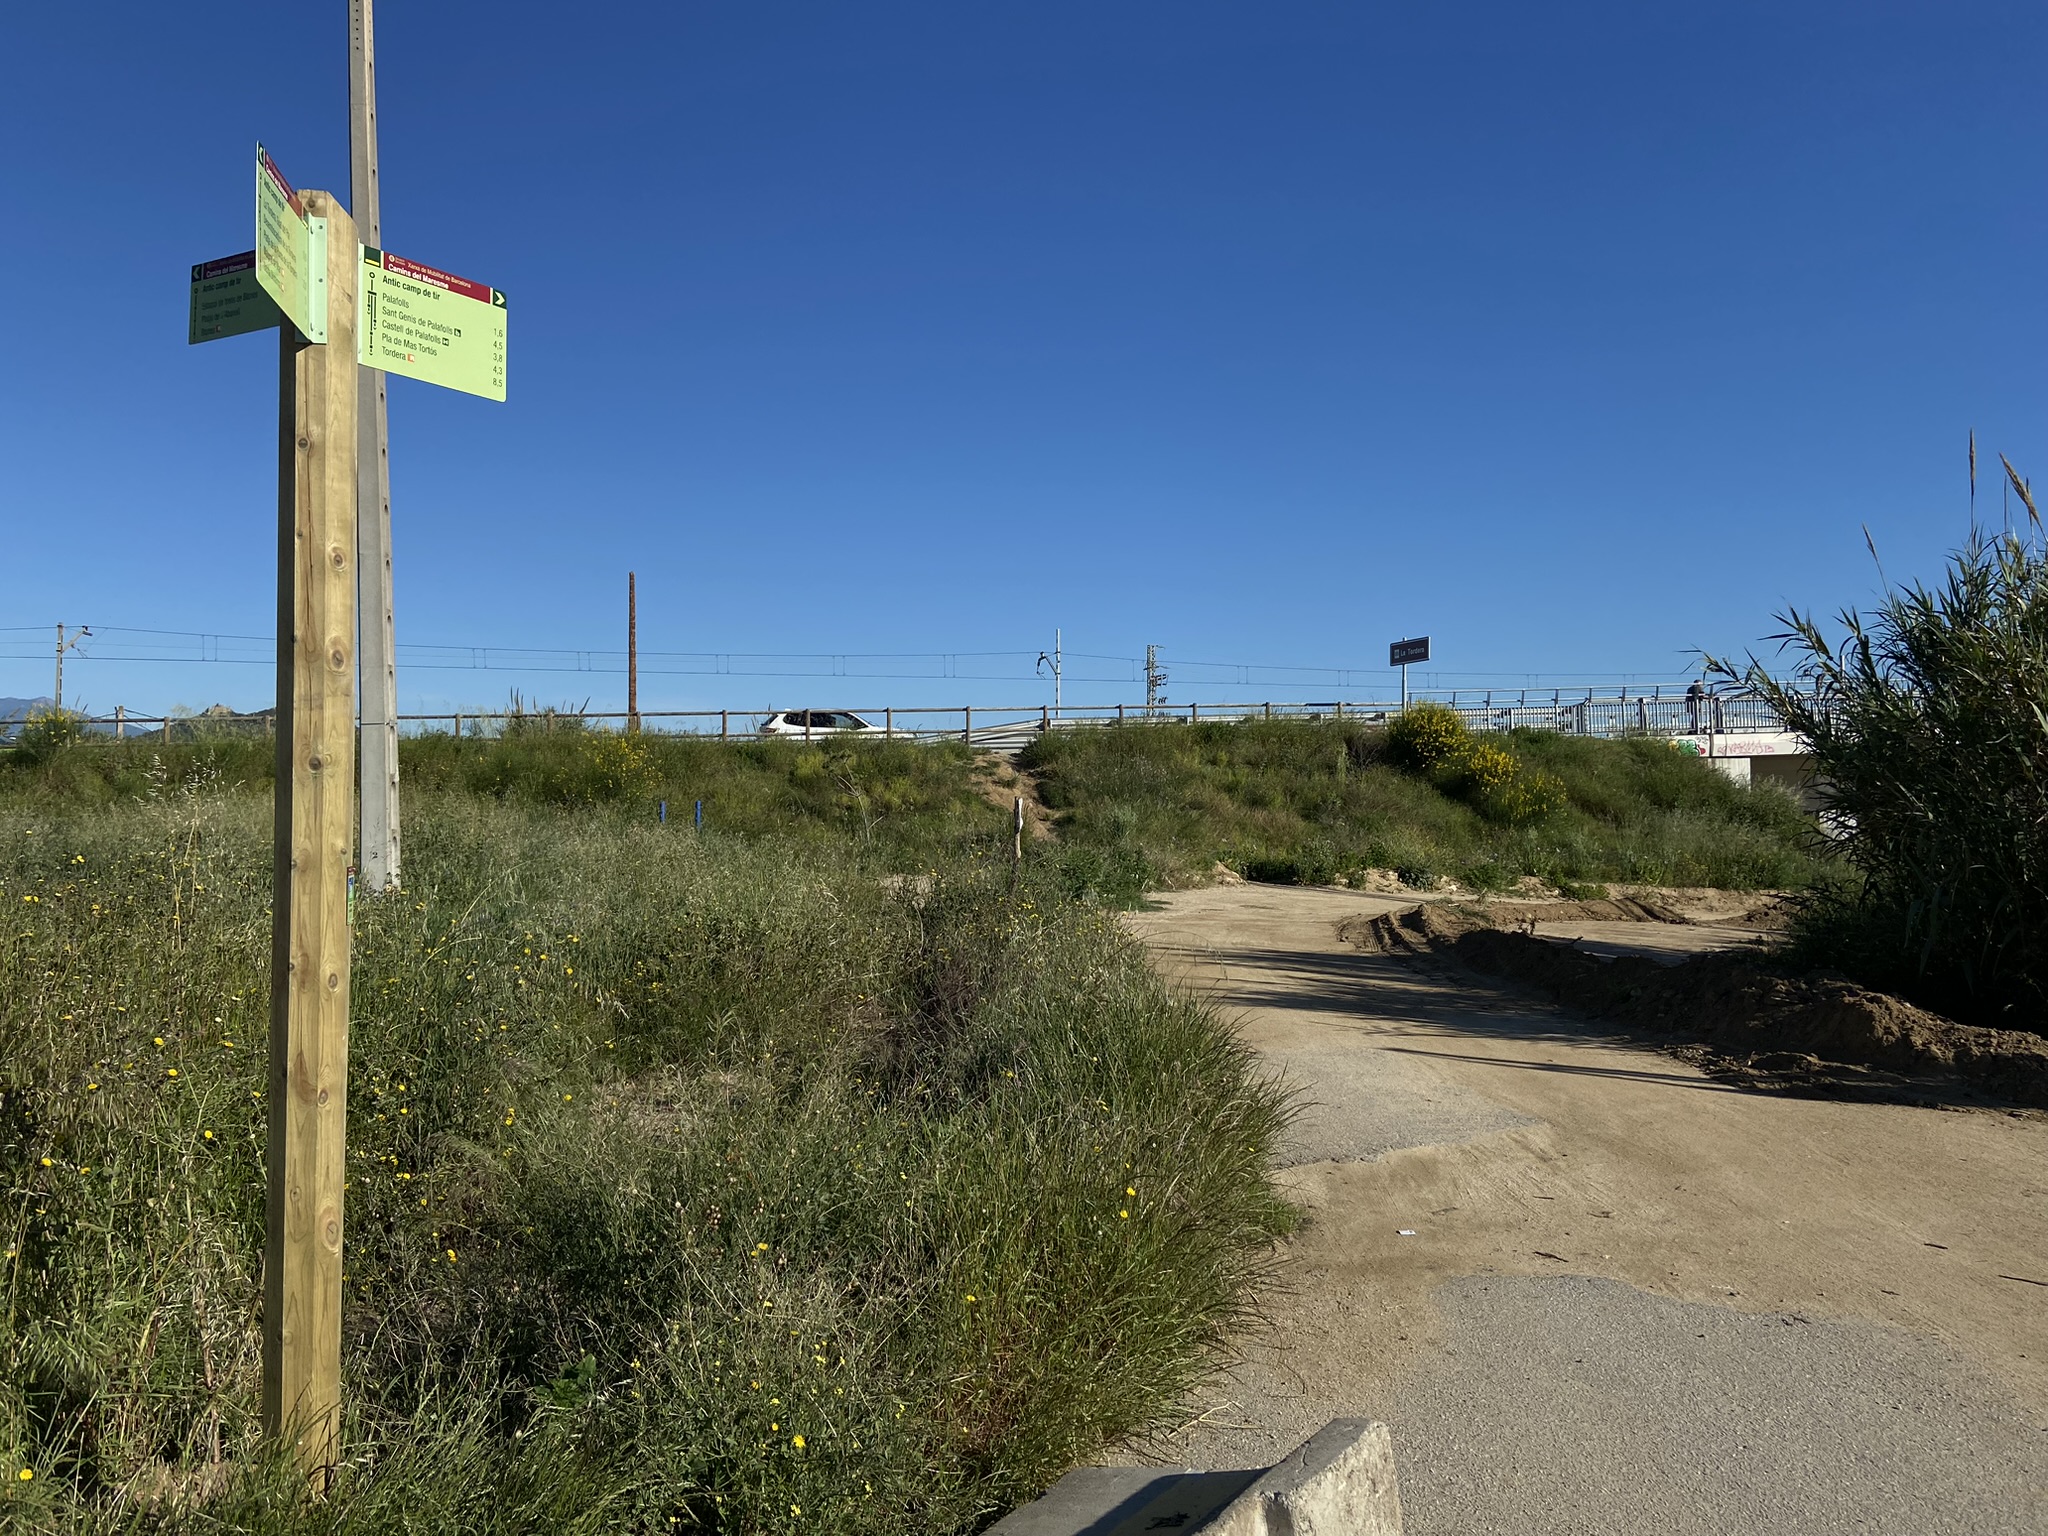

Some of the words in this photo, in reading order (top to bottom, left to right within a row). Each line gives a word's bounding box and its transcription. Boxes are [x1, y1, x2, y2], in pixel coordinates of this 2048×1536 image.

[388, 263, 411, 277] Camins
[412, 272, 422, 280] del
[422, 274, 449, 289] Maresme
[451, 276, 472, 288] Barcelona
[382, 275, 400, 288] Antic
[402, 282, 421, 295] camp
[422, 288, 431, 298] de
[432, 291, 440, 300] tir
[382, 292, 410, 309] Palafolls
[382, 306, 397, 318] Sant
[418, 318, 426, 327] de
[428, 320, 453, 335] Palafolls
[382, 319, 404, 333] Castell
[405, 327, 413, 336] de
[415, 329, 441, 344] Palafolls
[493, 328, 503, 338] 1,6
[382, 332, 392, 343] Pla
[393, 337, 402, 346] de
[404, 339, 417, 350] Mas
[493, 340, 503, 351] 4,5
[382, 346, 406, 361] Tordera
[493, 352, 503, 363] 3,8
[493, 365, 503, 375] 4,3
[493, 377, 503, 388] 8,5
[1408, 647, 1424, 655] Tordera
